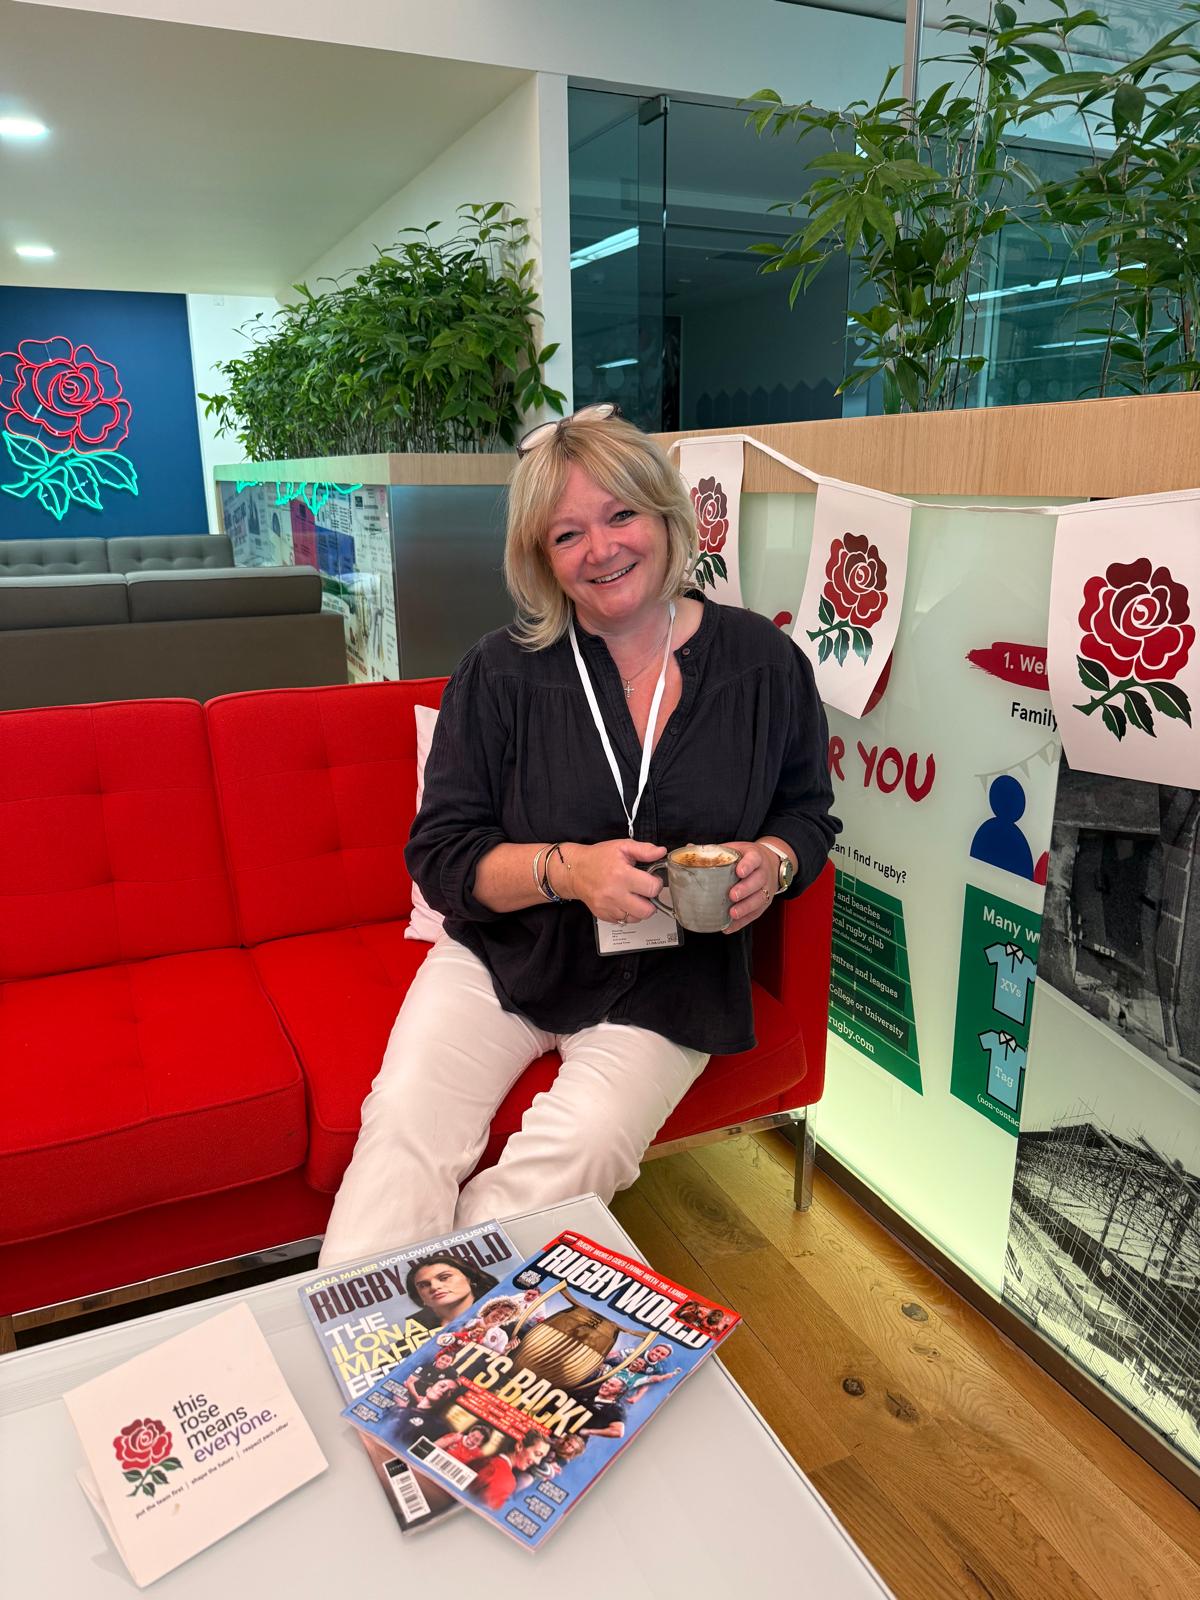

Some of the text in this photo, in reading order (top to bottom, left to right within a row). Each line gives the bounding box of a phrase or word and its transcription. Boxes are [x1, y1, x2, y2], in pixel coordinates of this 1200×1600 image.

[1004, 652, 1014, 669] 1.
[1012, 702, 1057, 732] Family
[857, 741, 935, 802] YOU
[832, 844, 845, 855] an
[854, 850, 871, 866] find
[874, 861, 906, 883] rugby?
[837, 893, 850, 904] and
[851, 897, 880, 920] beaches
[983, 906, 1040, 944] Many w
[846, 924, 867, 941] rugby
[868, 935, 884, 950] club
[831, 953, 898, 998] entres and leagues
[1000, 978, 1022, 998] XVs
[829, 984, 904, 1038] College or University
[995, 1066, 1014, 1087] Tag
[977, 1094, 1020, 1127] (non-contac
[304, 1223, 495, 1294] ILONA MAHER WORLDWIDE EXCLUSIVE
[537, 1245, 632, 1299] RUGBY
[309, 1265, 406, 1324] RUGBY
[325, 1312, 388, 1344] THE
[331, 1319, 429, 1365] ILONA
[172, 1394, 207, 1419] this
[450, 1342, 593, 1438] IT'S BACK!
[180, 1404, 220, 1434] rose
[187, 1406, 247, 1450] means
[194, 1410, 277, 1462] everyone.
